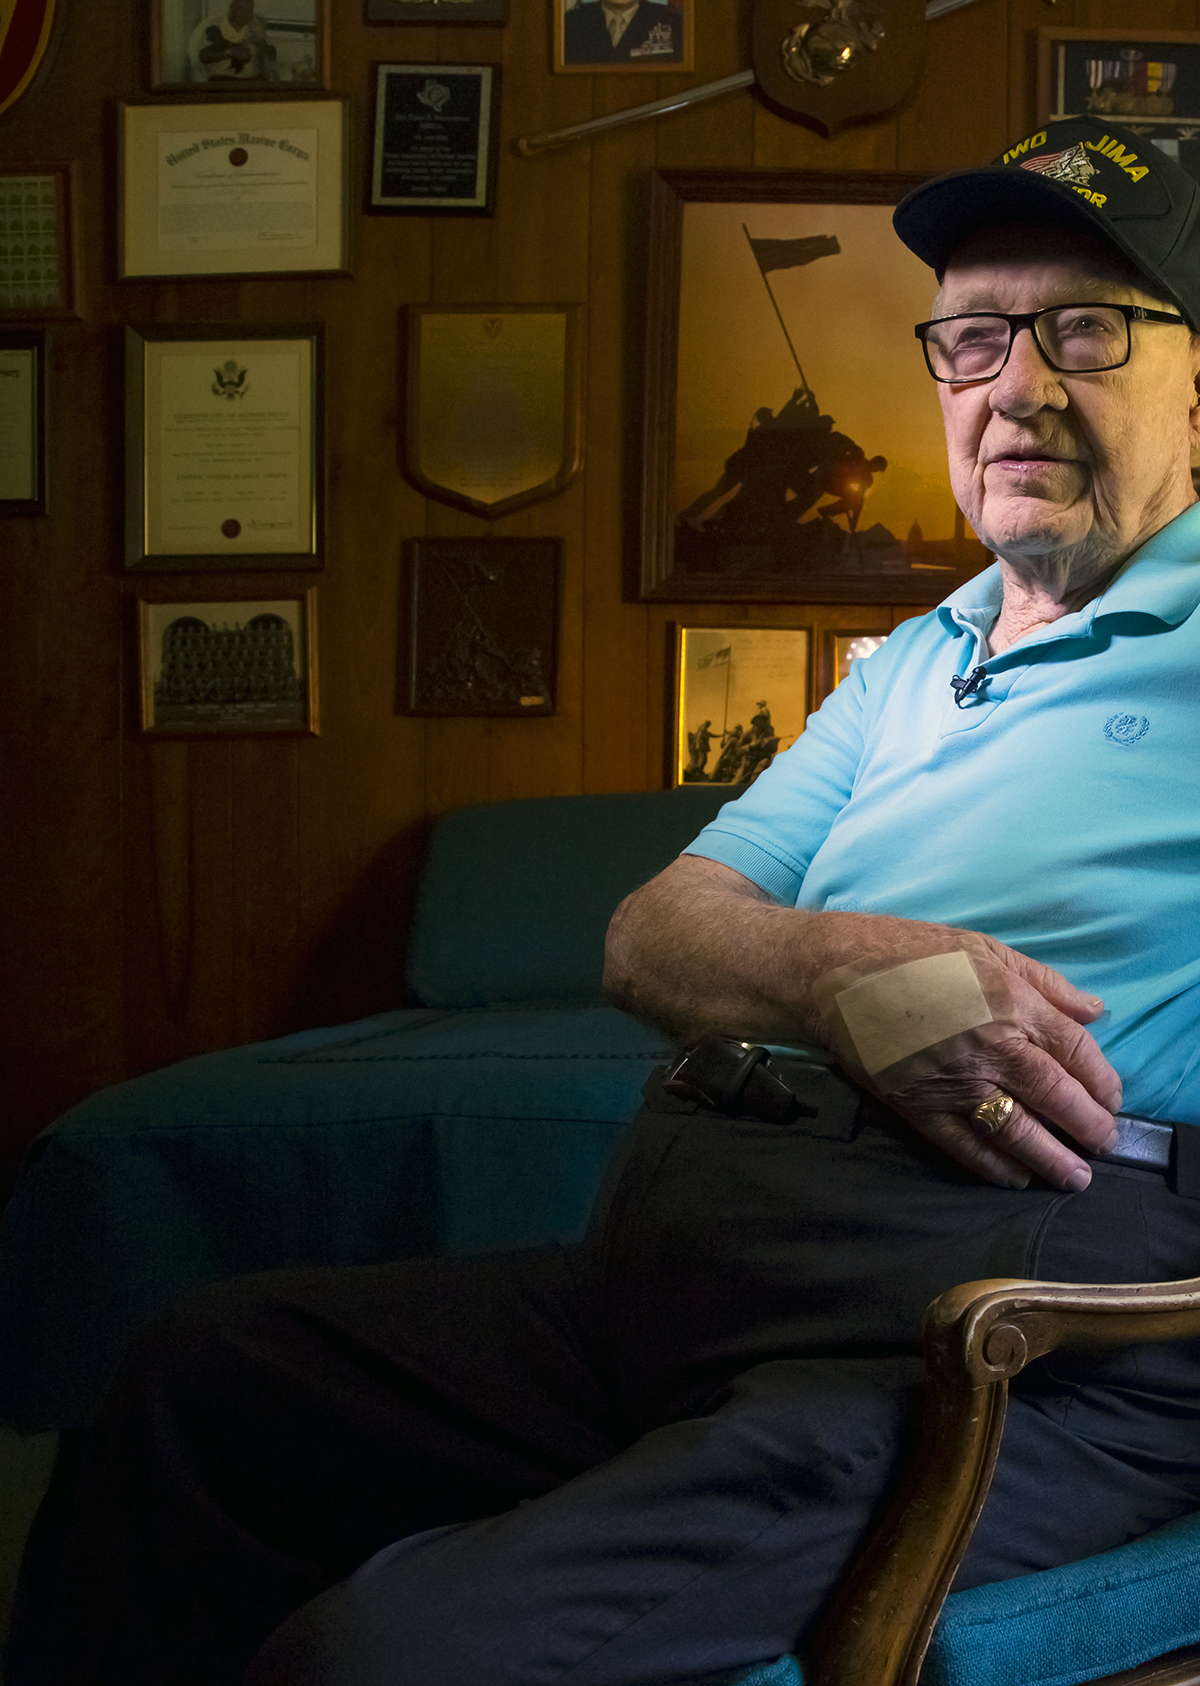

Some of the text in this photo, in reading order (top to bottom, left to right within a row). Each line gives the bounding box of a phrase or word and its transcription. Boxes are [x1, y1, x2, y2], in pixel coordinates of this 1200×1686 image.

[165, 132, 311, 167] United States Marine Corps
[1002, 130, 1150, 183] IWO JIMA
